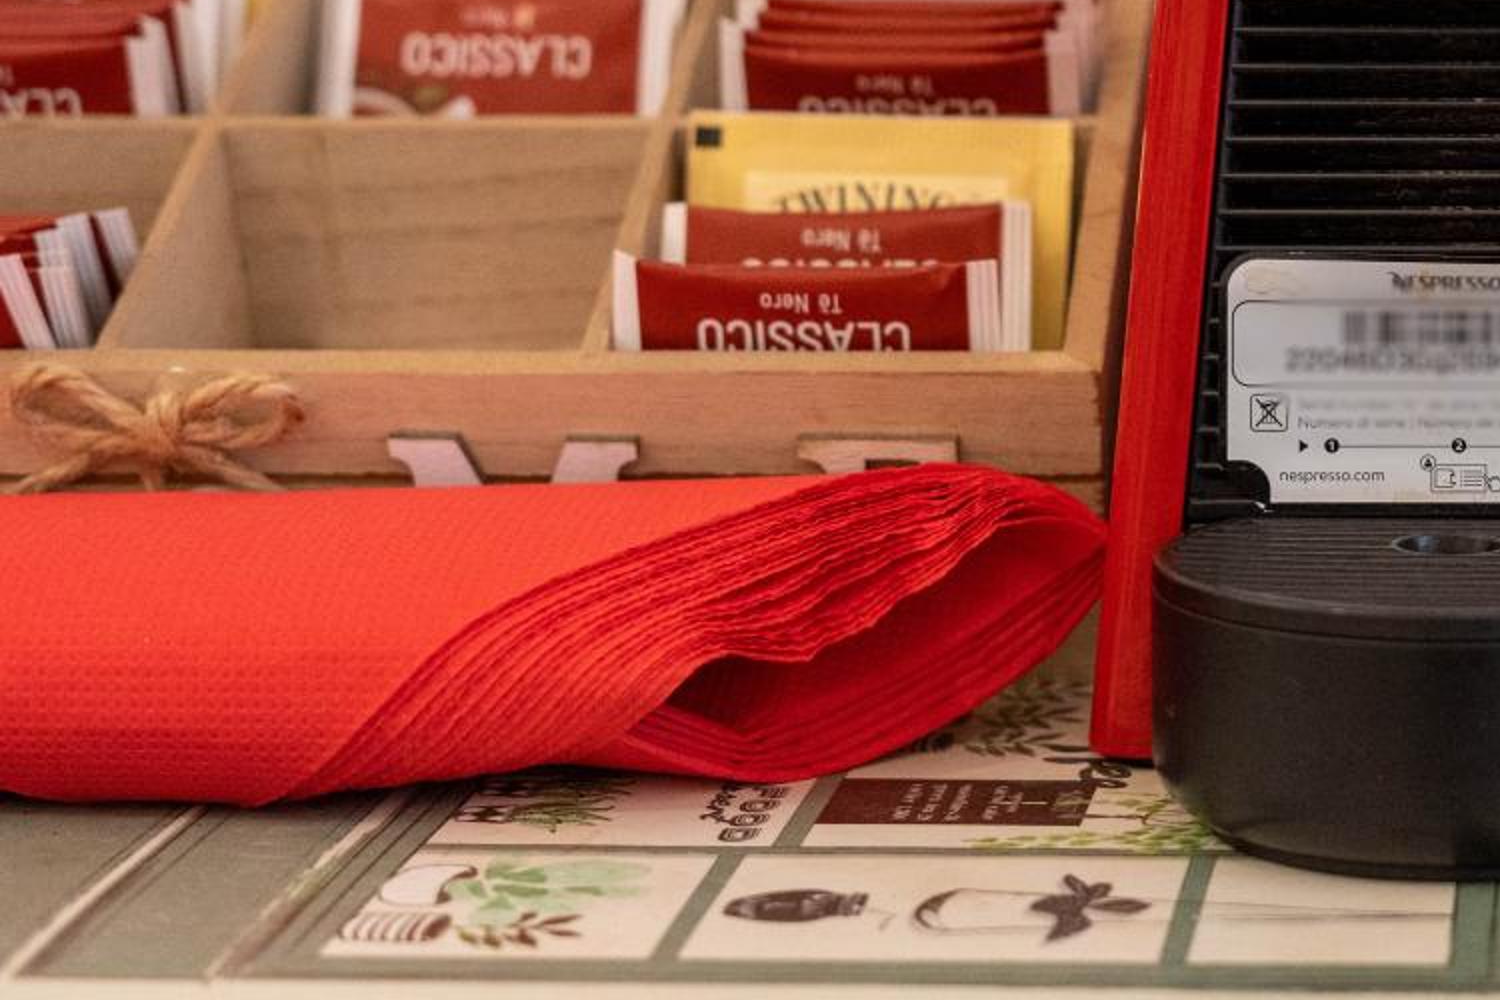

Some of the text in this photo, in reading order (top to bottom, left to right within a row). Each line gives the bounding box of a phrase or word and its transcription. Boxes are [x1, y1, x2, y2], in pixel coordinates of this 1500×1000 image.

[402, 31, 592, 80] CLASSICO
[760, 292, 810, 314] Nero
[697, 319, 911, 351] CLASSICO
[1279, 469, 1385, 484] nespresso.com
